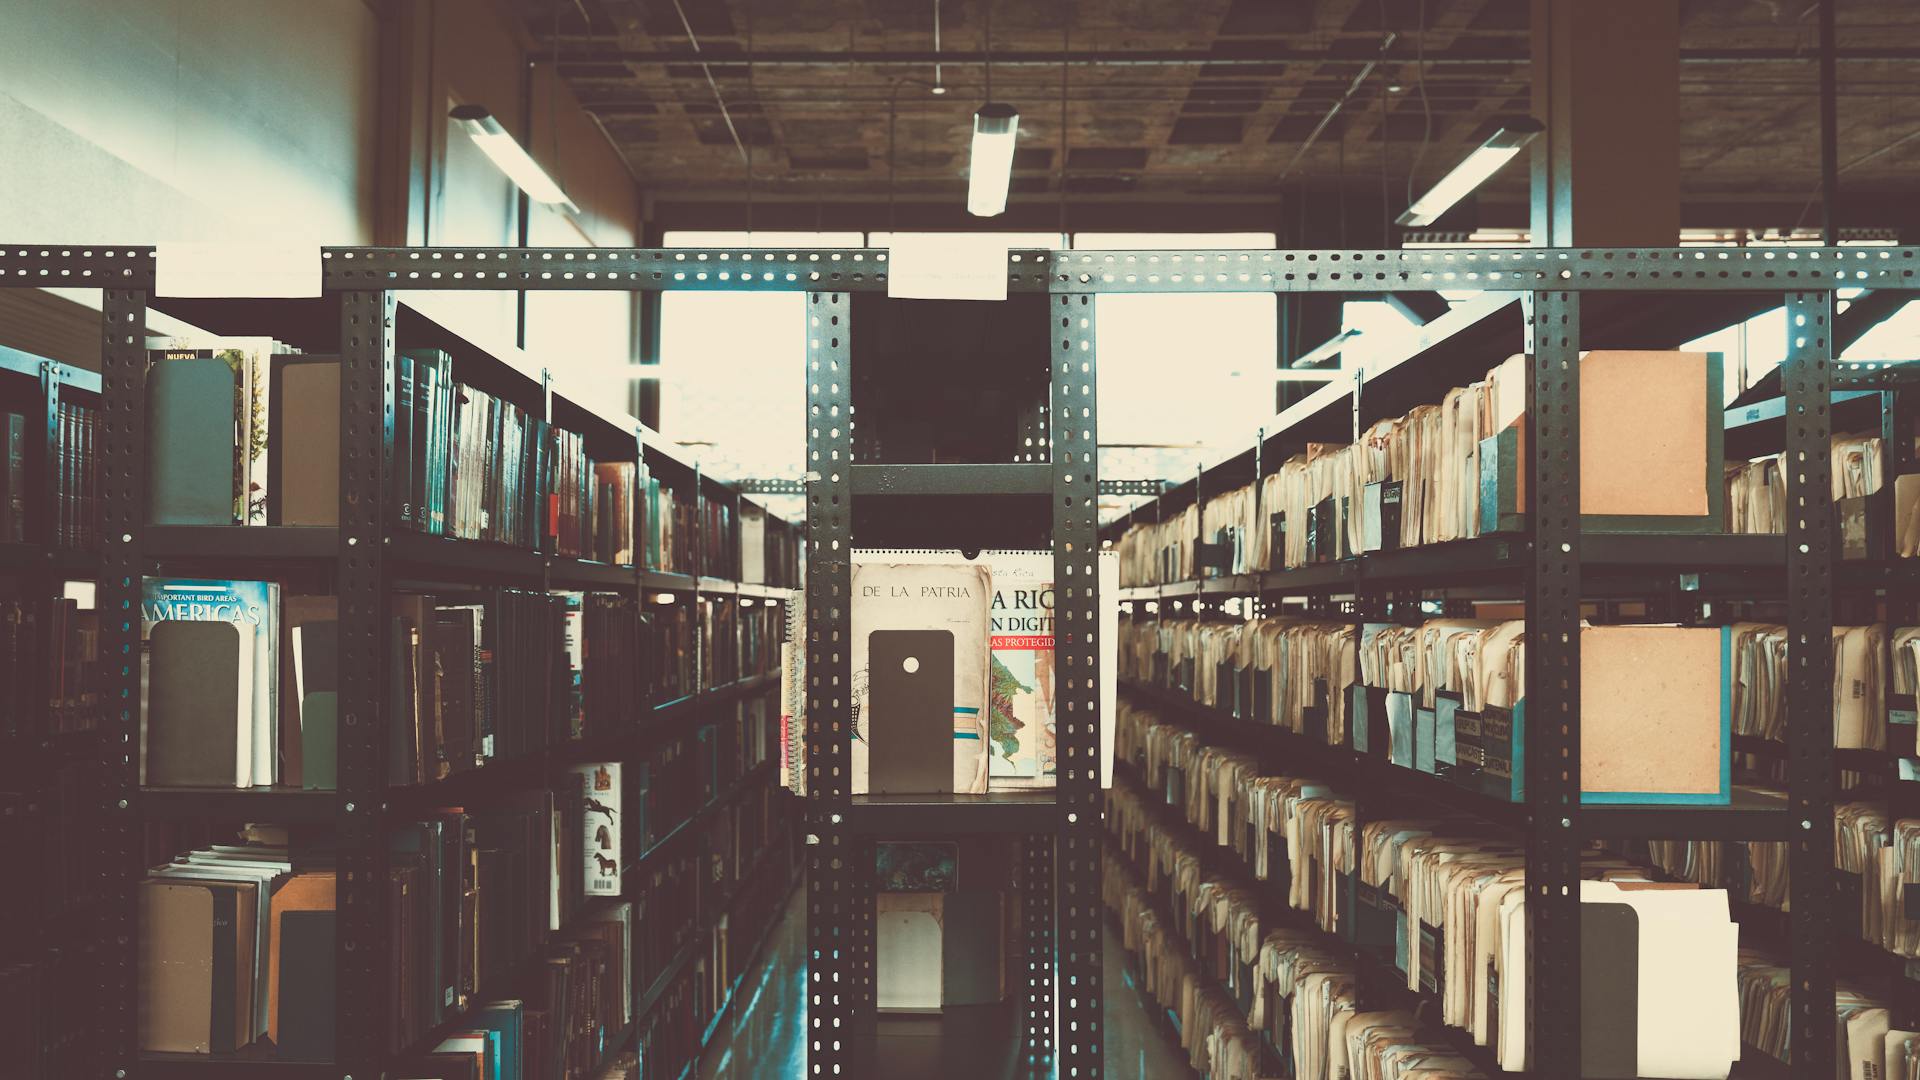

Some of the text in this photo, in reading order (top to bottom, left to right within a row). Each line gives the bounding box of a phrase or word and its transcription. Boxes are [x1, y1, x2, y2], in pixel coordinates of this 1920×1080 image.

[863, 586, 970, 598] DE LA PATRIA
[154, 593, 194, 602] IMPORTANT
[196, 594, 214, 602] BIRD
[989, 638, 1003, 647] AS
